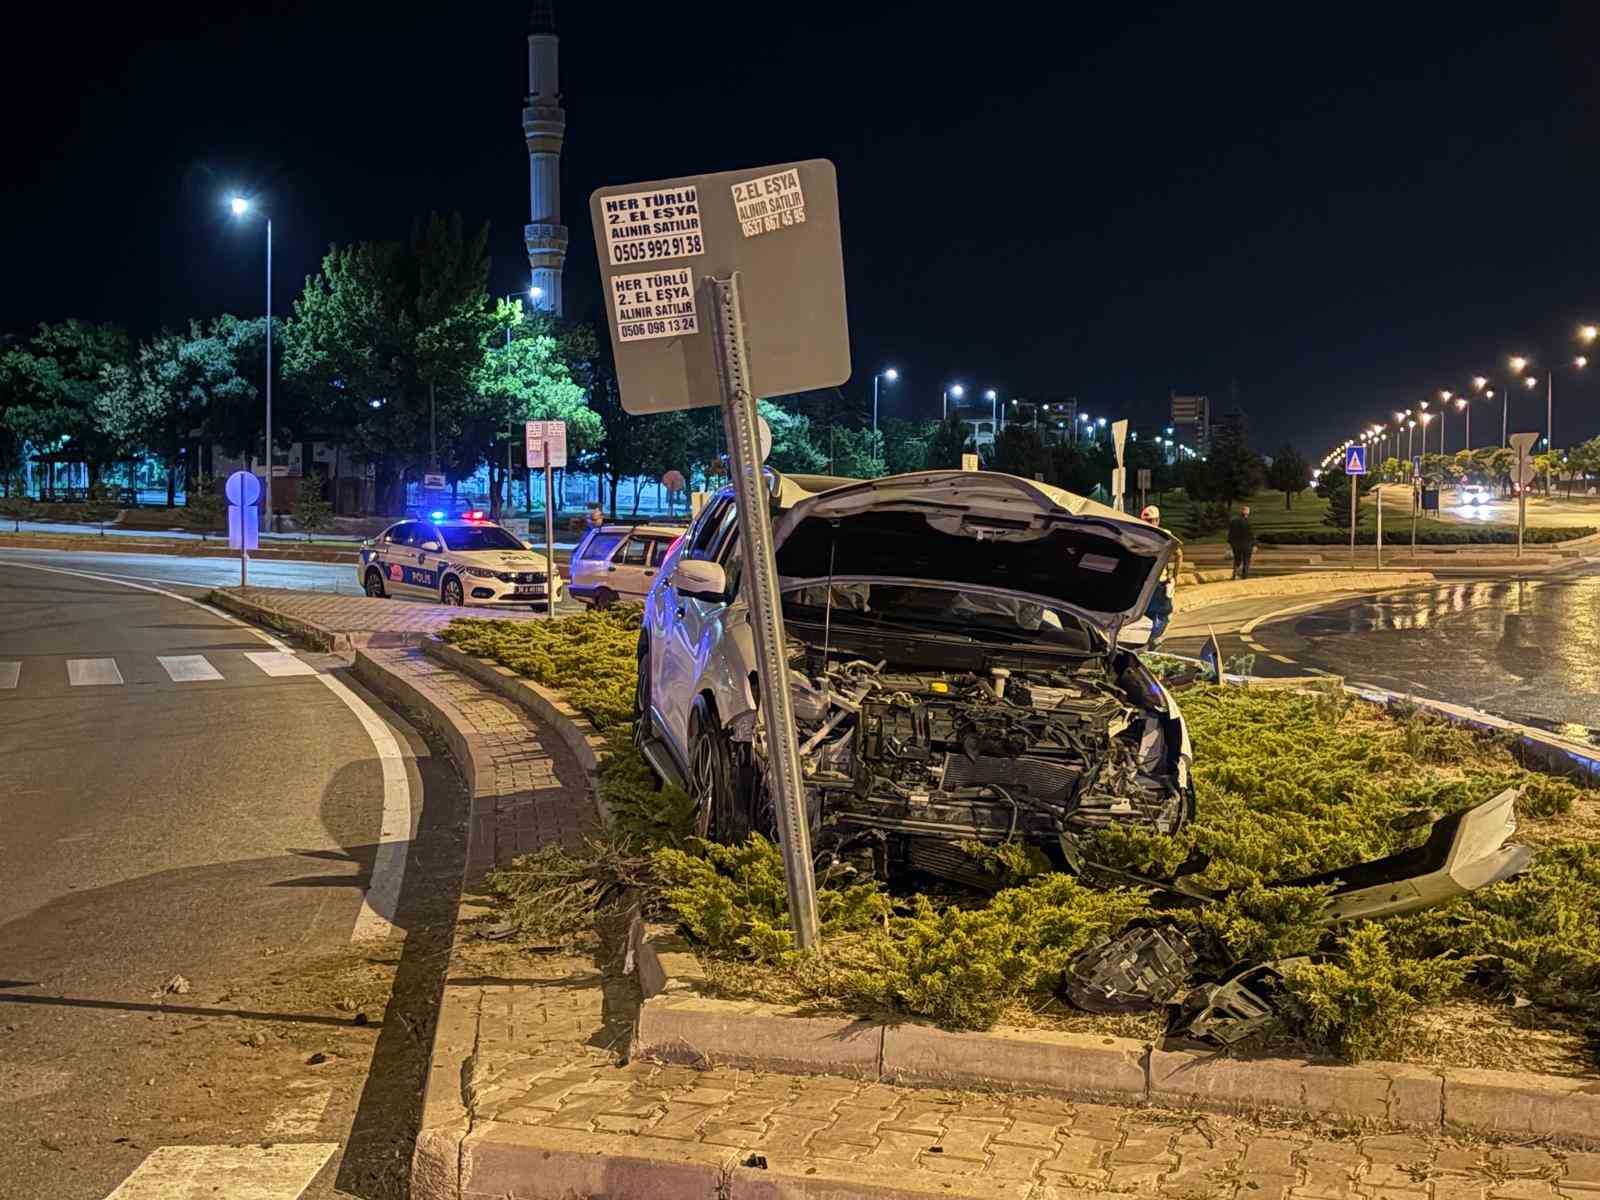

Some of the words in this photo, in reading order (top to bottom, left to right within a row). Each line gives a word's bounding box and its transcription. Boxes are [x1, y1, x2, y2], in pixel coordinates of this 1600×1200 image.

[606, 199, 639, 212] HER
[642, 189, 696, 208] TÜRLÜ
[739, 200, 768, 220] ALINIR
[769, 192, 802, 212] SATILIR
[609, 214, 625, 225] 2.
[629, 211, 649, 222] EL
[653, 205, 697, 219] EŞYA
[612, 224, 651, 239] ALINIR
[654, 218, 699, 233] SATILIR
[614, 242, 646, 262] 0505
[648, 240, 670, 258] 992
[616, 279, 642, 292] HER
[646, 271, 688, 288] TÜRLÜ
[618, 294, 631, 305] 2.
[636, 291, 652, 304] EL
[656, 287, 690, 302] EŞYA
[620, 306, 652, 320] ALINIR
[655, 302, 693, 316] SATILIR
[621, 323, 645, 337] 0506
[669, 319, 680, 332] 13
[682, 318, 694, 330] 24
